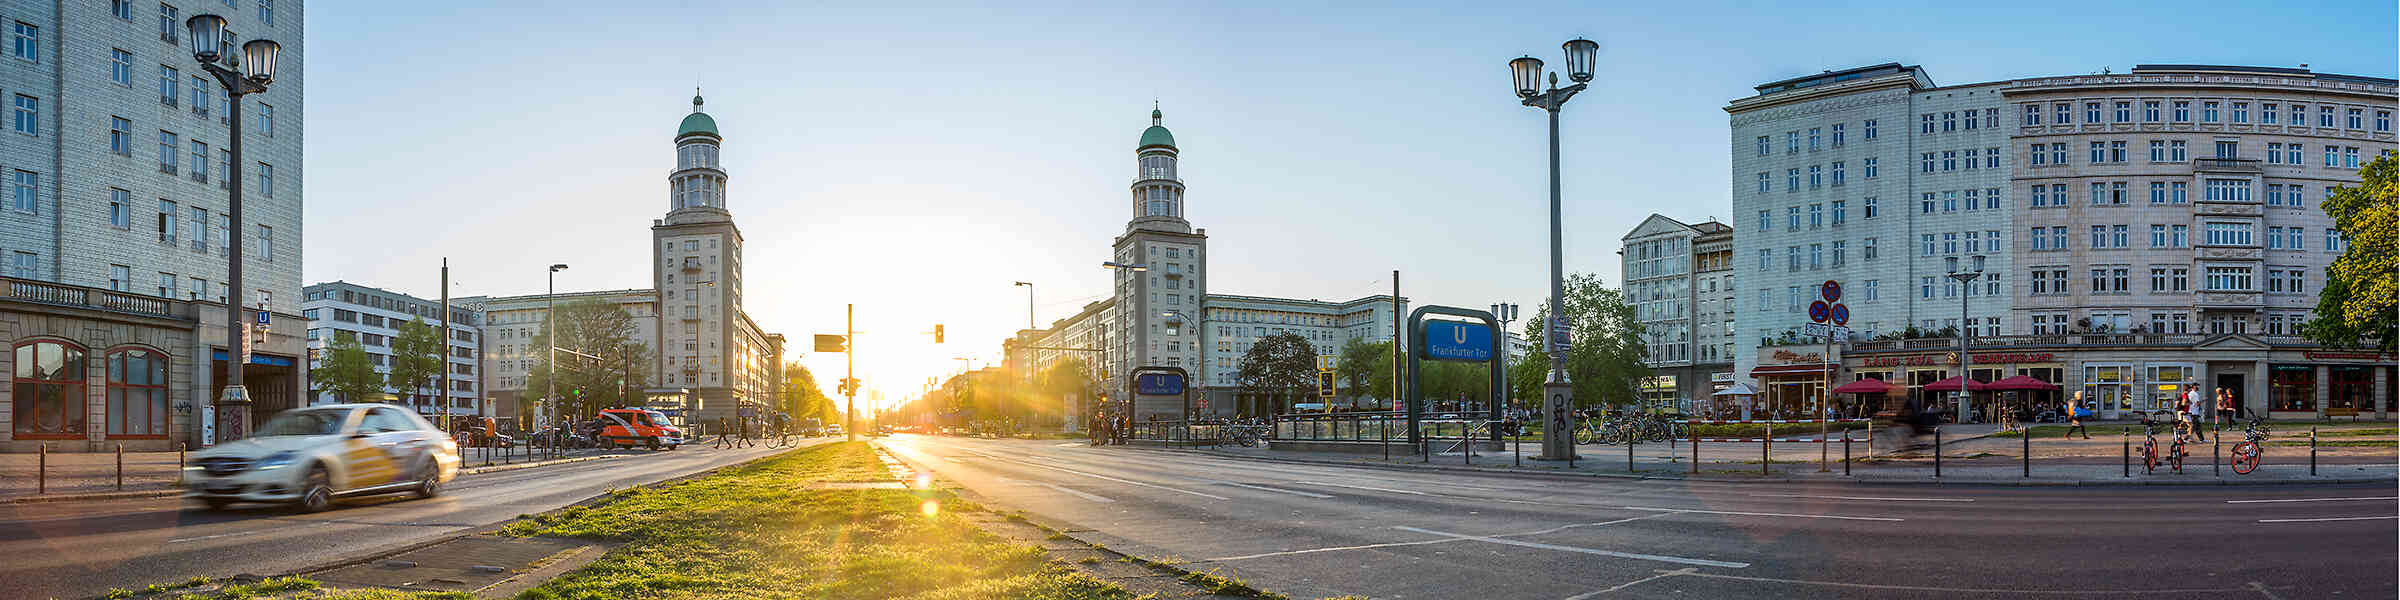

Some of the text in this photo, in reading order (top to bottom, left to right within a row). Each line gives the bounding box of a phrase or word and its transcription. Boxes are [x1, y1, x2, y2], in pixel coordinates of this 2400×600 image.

[259, 312, 268, 323] U
[1454, 325, 1467, 344] U
[1432, 345, 1489, 358] Frankfurter Tor
[1972, 351, 2052, 363] RESTAURANT
[1156, 375, 1165, 387] U
